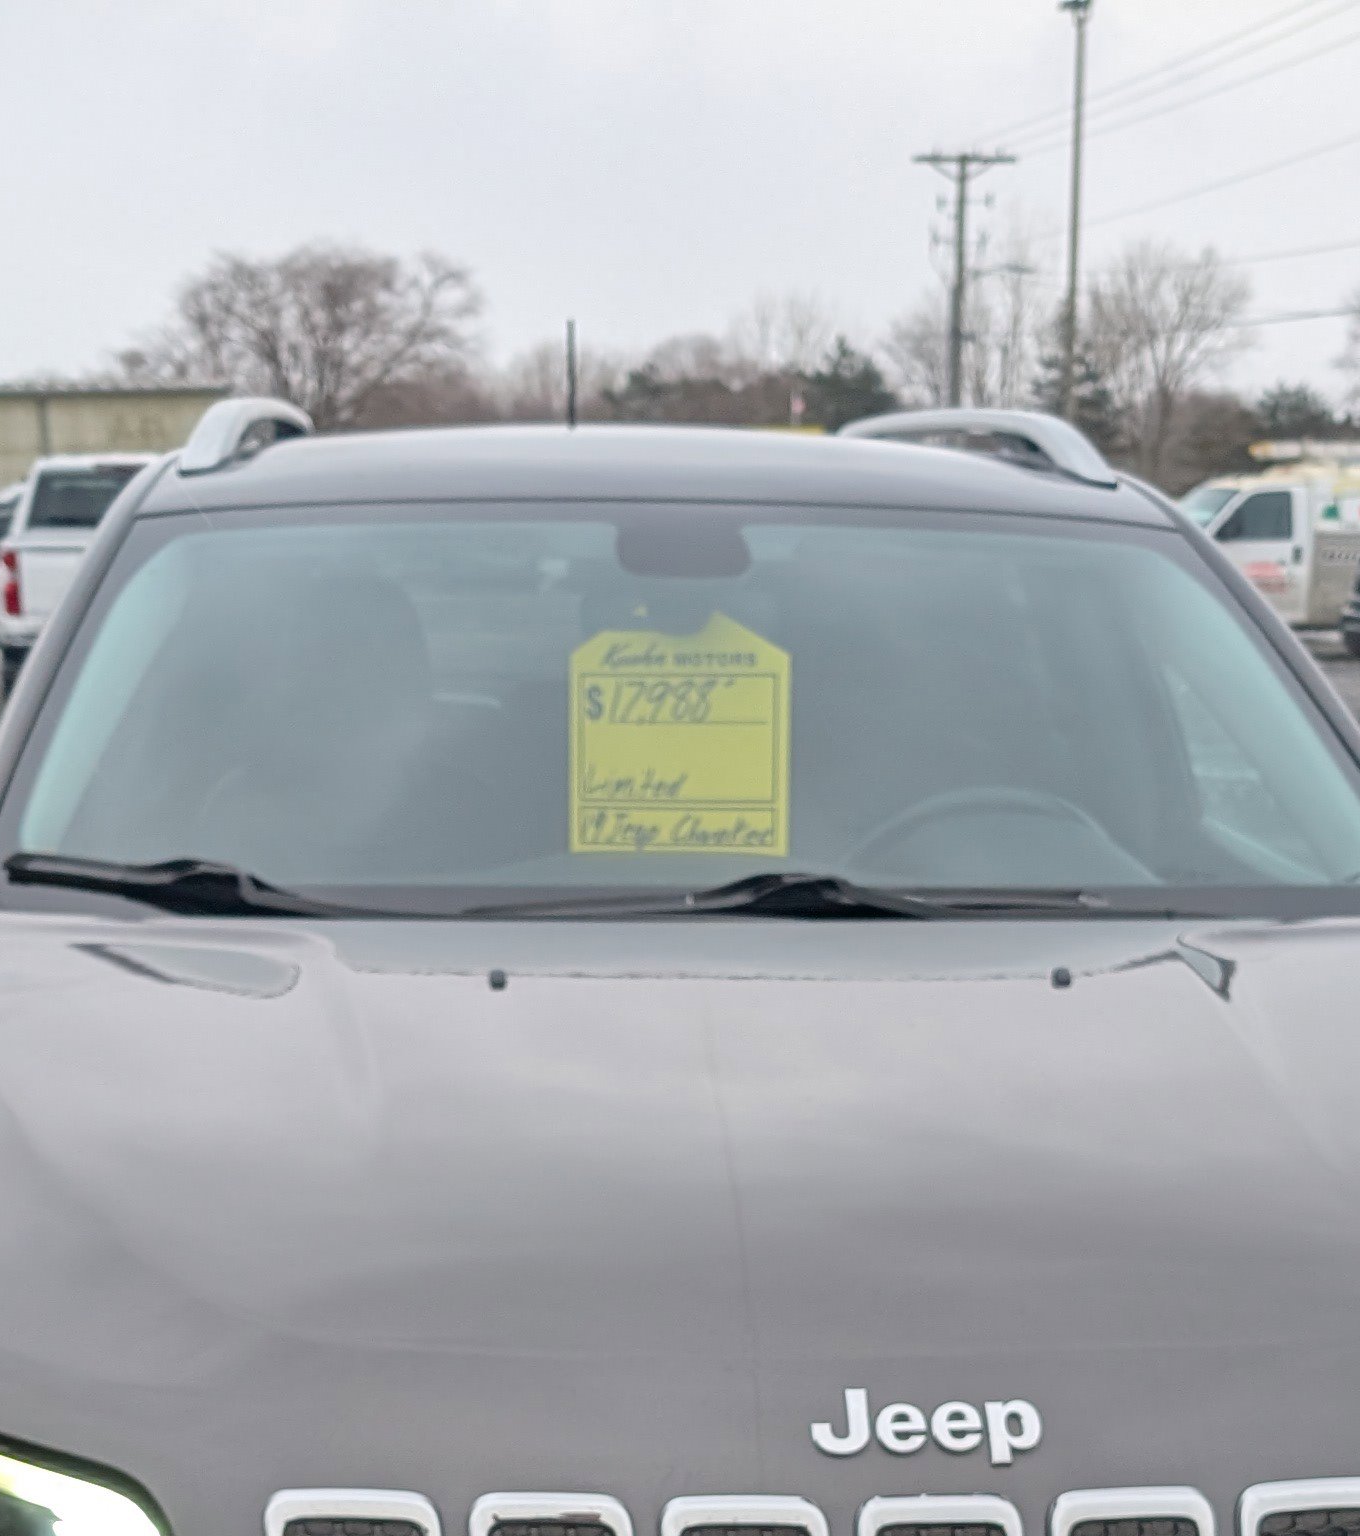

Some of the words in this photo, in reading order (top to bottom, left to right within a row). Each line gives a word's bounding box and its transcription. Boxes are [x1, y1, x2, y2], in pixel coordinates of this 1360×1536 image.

[673, 652, 758, 667] MOTORS
[585, 766, 688, 797] Limited
[811, 1387, 1042, 1466] Jeep
